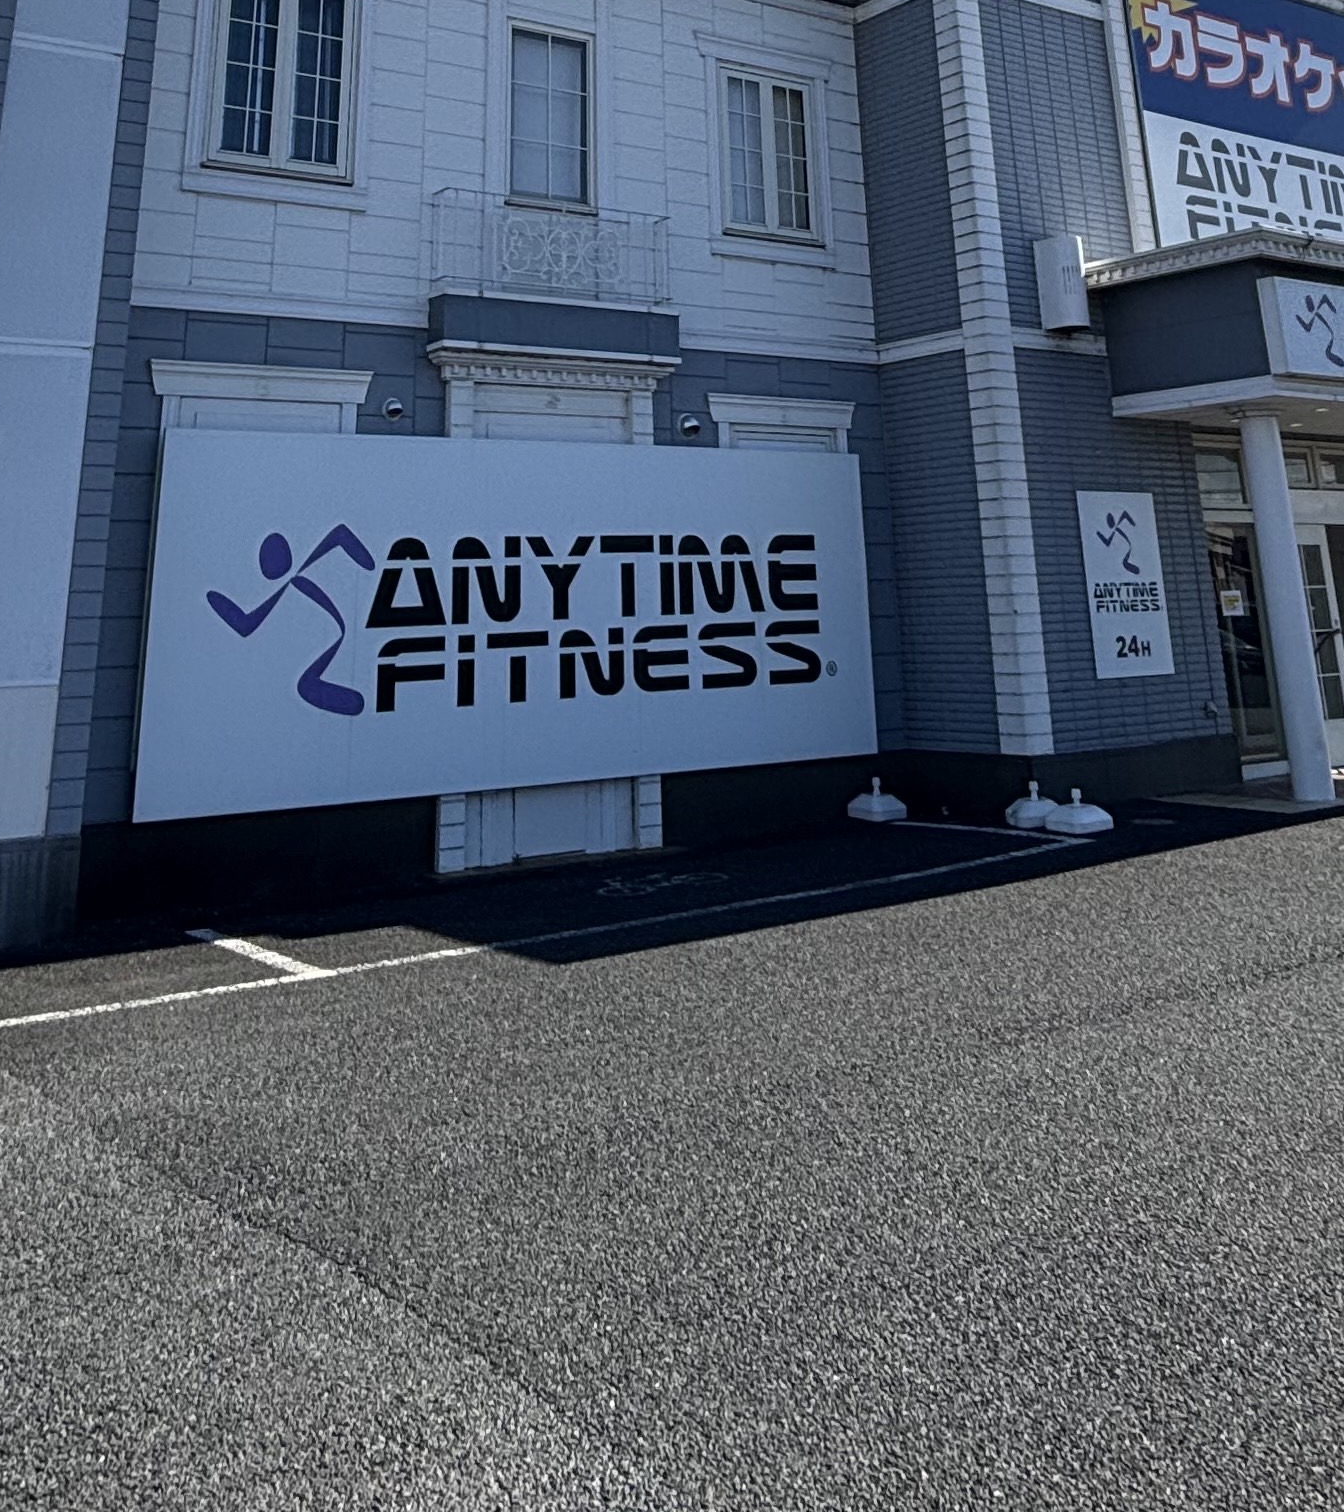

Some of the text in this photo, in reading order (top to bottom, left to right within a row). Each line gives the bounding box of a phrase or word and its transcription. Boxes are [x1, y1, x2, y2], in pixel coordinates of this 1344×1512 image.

[1144, 2, 1335, 111] カラオケ
[365, 534, 820, 629] ANYTIME
[1093, 581, 1160, 599] ANYTIME
[1096, 598, 1161, 614] FITNESS
[375, 619, 822, 713] FITNESS
[1115, 635, 1152, 659] 24H
